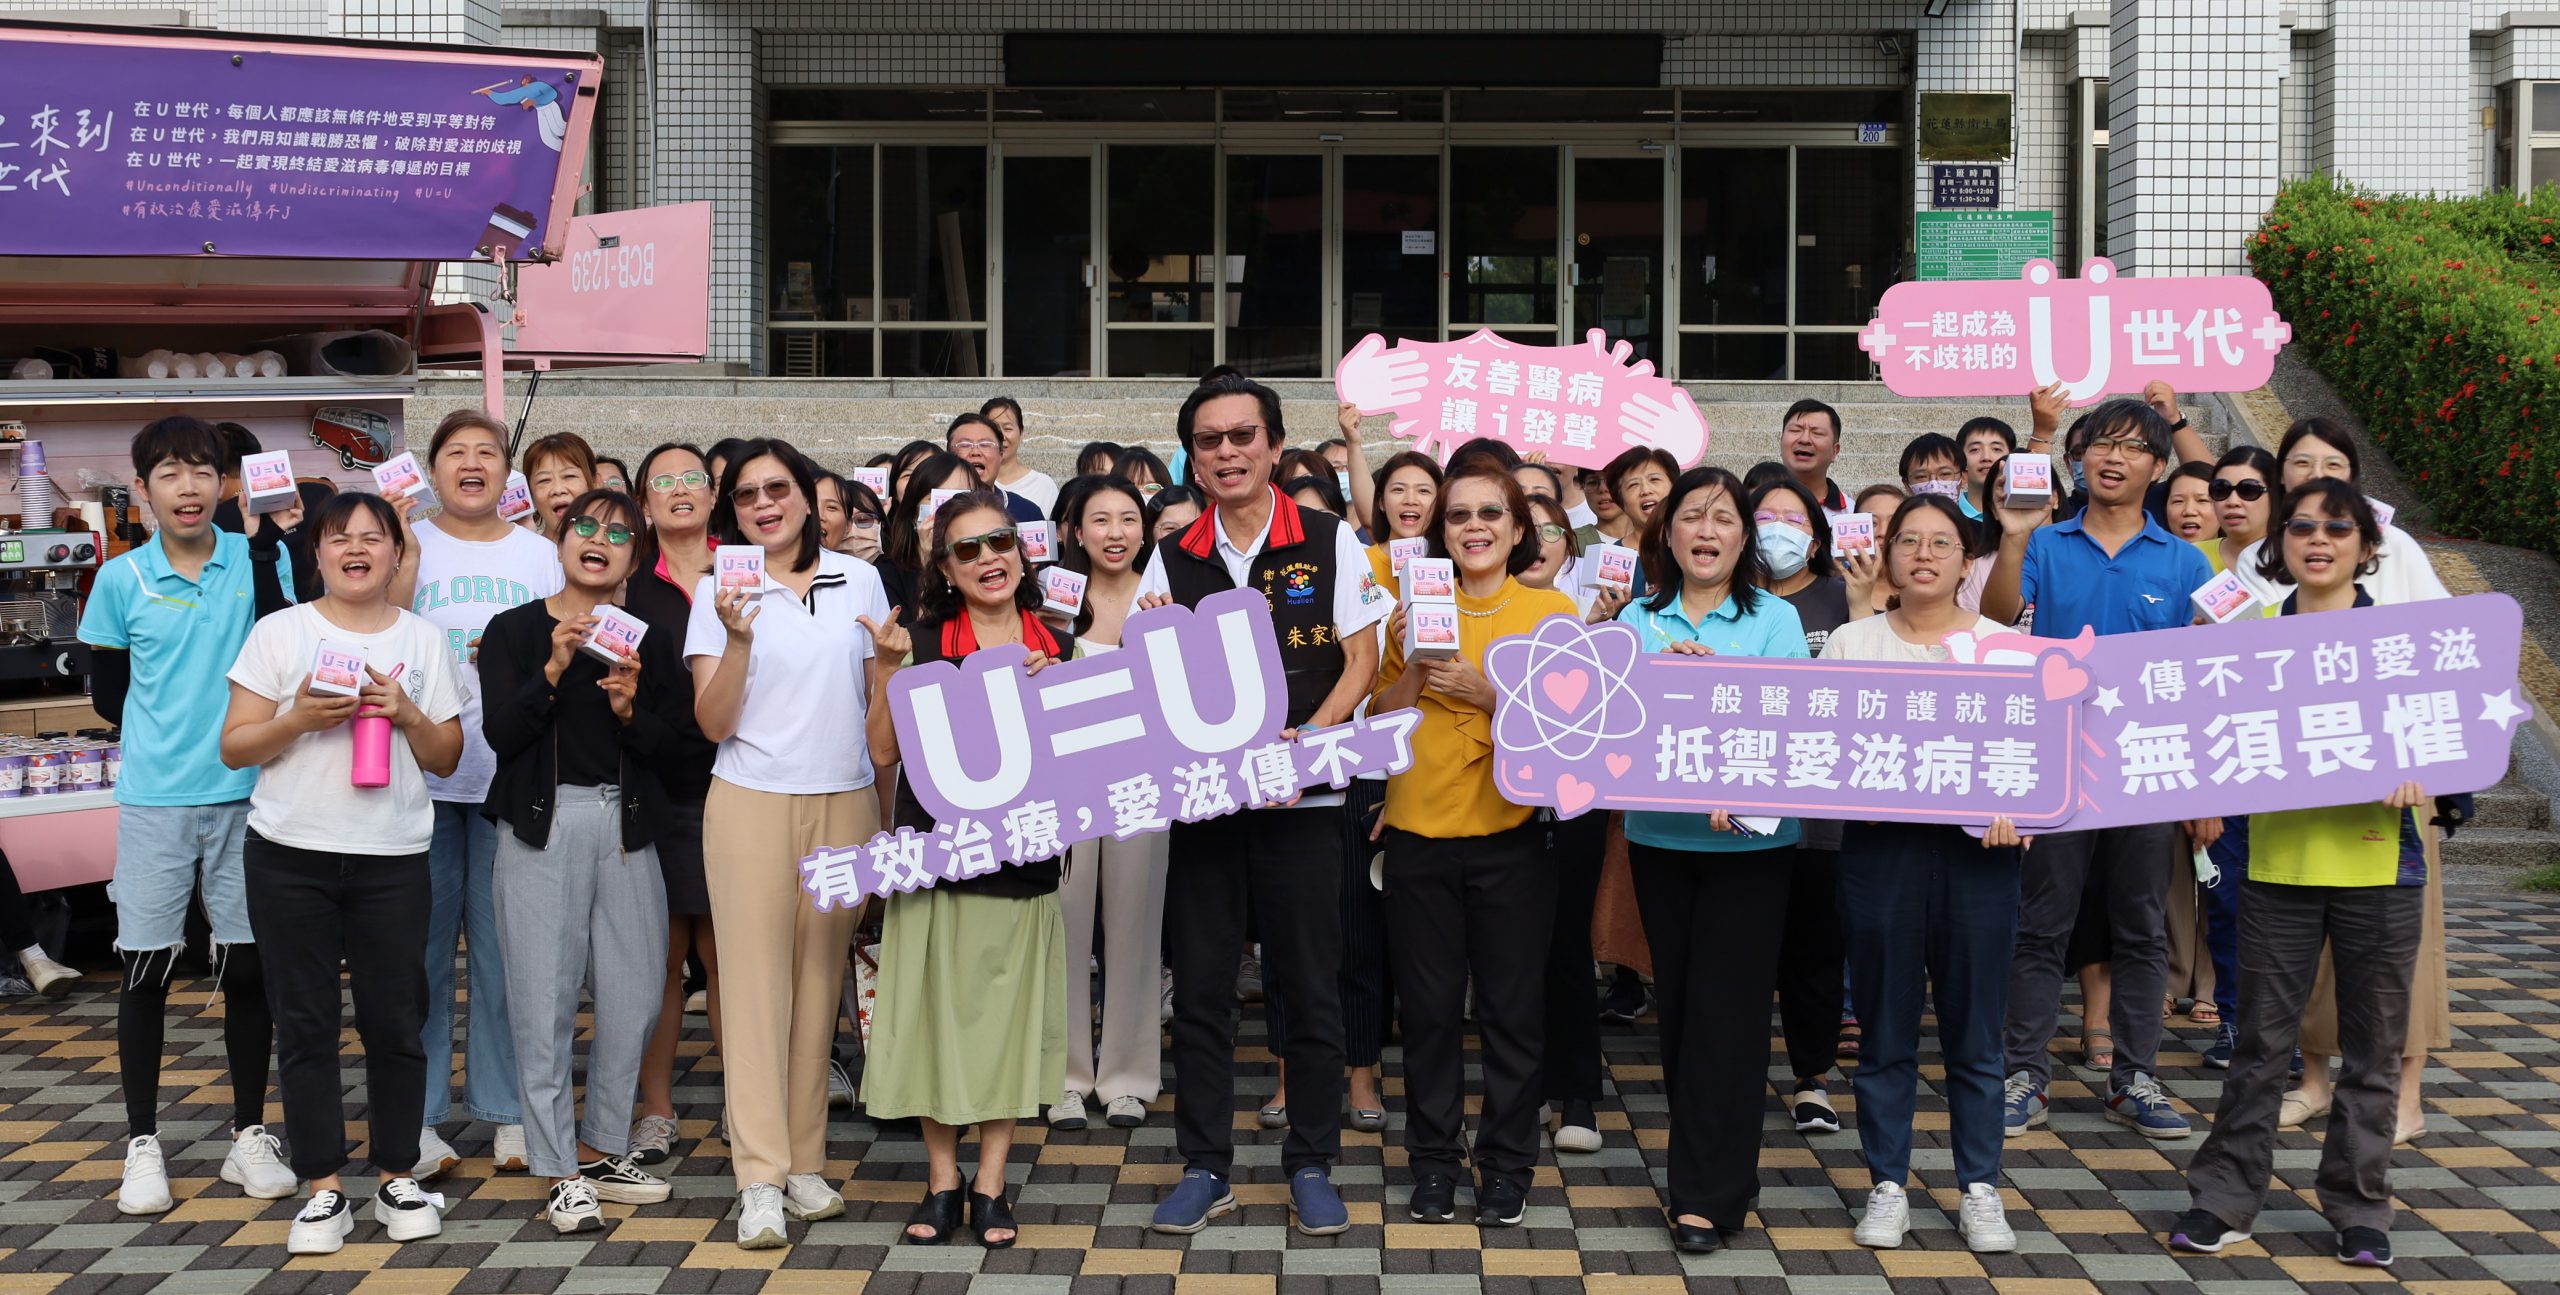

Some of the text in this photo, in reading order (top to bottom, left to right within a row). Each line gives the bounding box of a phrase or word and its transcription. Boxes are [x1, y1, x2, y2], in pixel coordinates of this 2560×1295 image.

[0, 103, 114, 157] 來到
[1863, 131, 1880, 142] 200
[126, 180, 253, 200] #Unconditionally
[269, 183, 400, 203] #Undiscriminating
[1943, 168, 1993, 179] 上班時間
[572, 242, 655, 293] BCB-1239
[1903, 310, 2017, 339] 一起成為
[2123, 307, 2246, 368] 世代
[1443, 352, 1605, 408] 友善醫病
[1904, 342, 2018, 371] 不歧視的
[413, 575, 546, 616] FLORID
[2138, 626, 2481, 705] 傳不了的愛滋
[908, 608, 1267, 811] U=U
[1662, 683, 2037, 727] 一般醫療防護就能
[1655, 724, 2040, 797] 抵禦愛滋病毒
[2115, 690, 2469, 796] 無須畏懼
[803, 709, 1419, 909] 有效治療，愛滋傳不了
